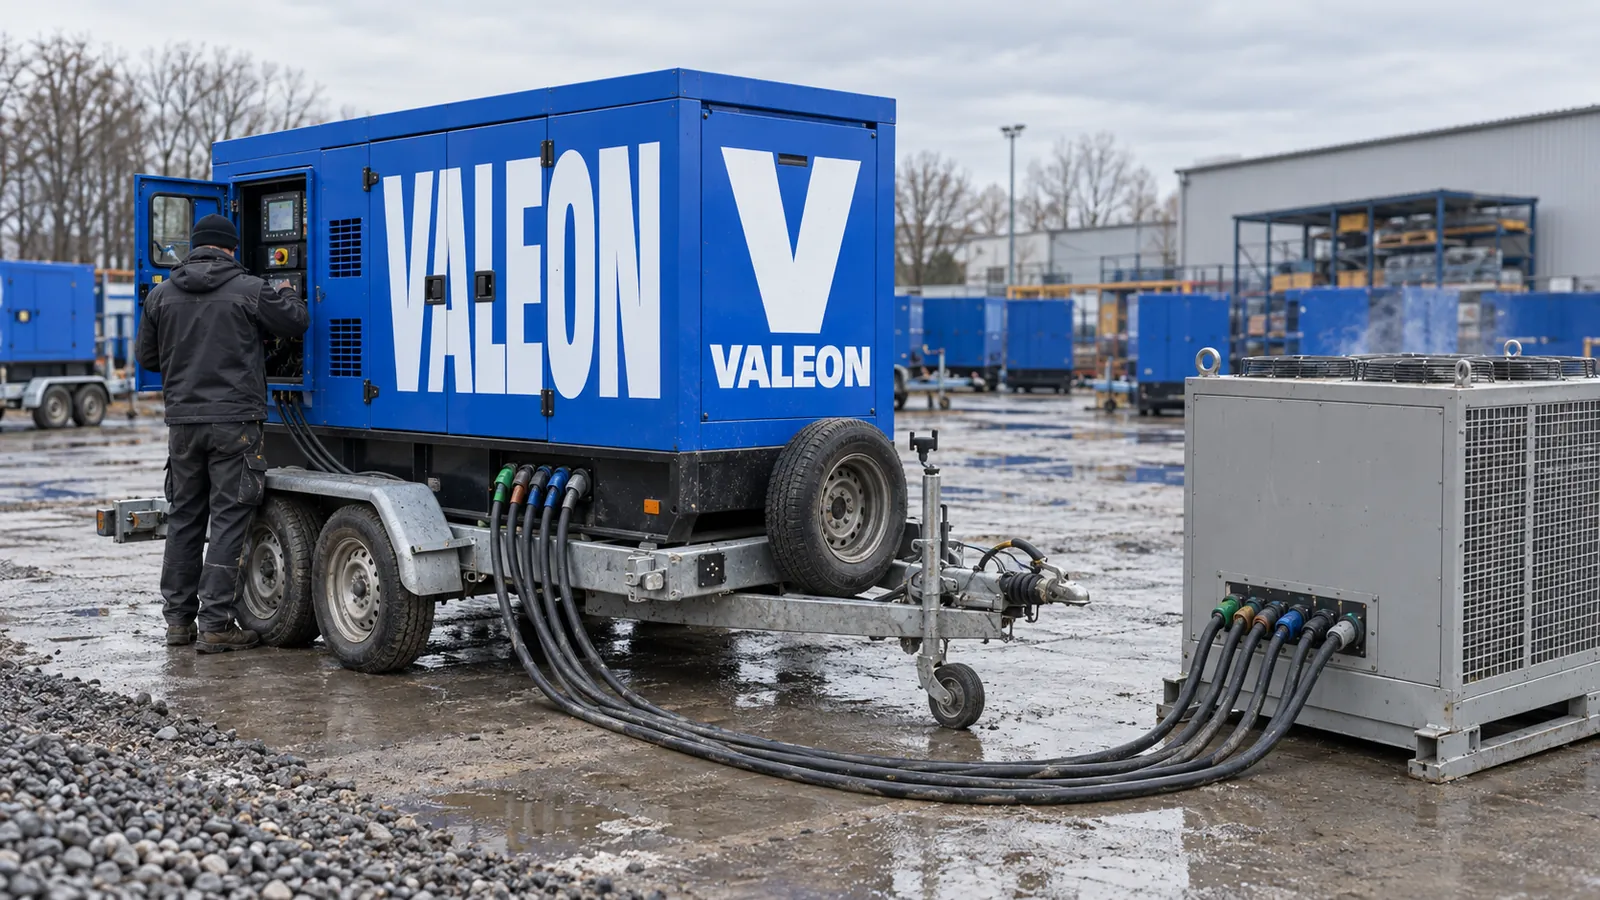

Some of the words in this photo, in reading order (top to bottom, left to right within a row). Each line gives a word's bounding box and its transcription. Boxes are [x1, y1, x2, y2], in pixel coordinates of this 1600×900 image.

[383, 141, 661, 399] VALEON
[720, 147, 861, 334] V
[710, 344, 870, 389] VALEON
